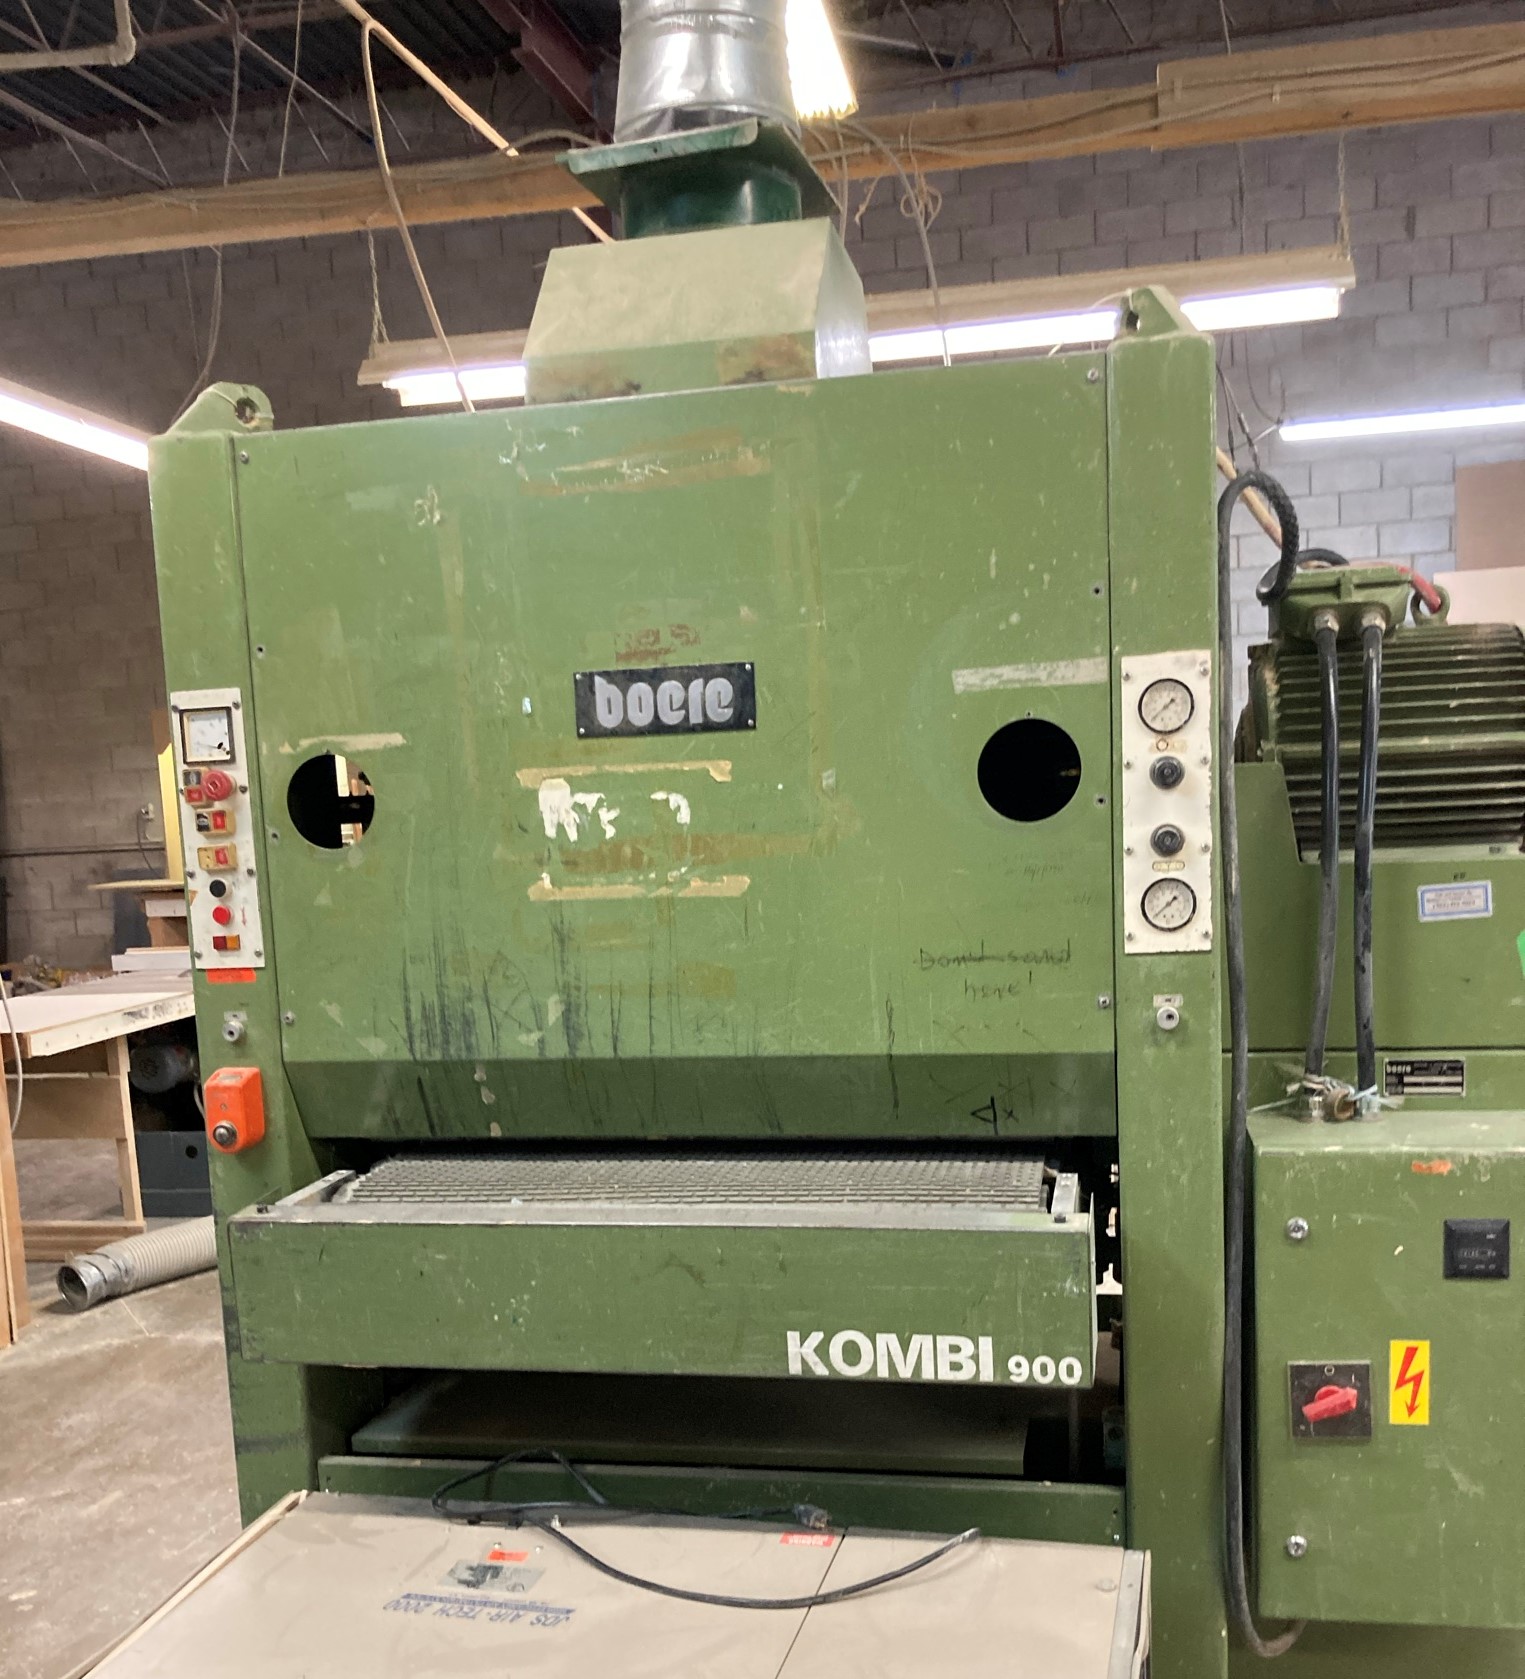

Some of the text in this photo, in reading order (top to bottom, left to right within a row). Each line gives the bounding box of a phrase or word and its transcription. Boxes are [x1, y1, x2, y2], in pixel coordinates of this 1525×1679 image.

[594, 674, 735, 729] boere
[786, 1330, 1083, 1386] KOMBI 900
